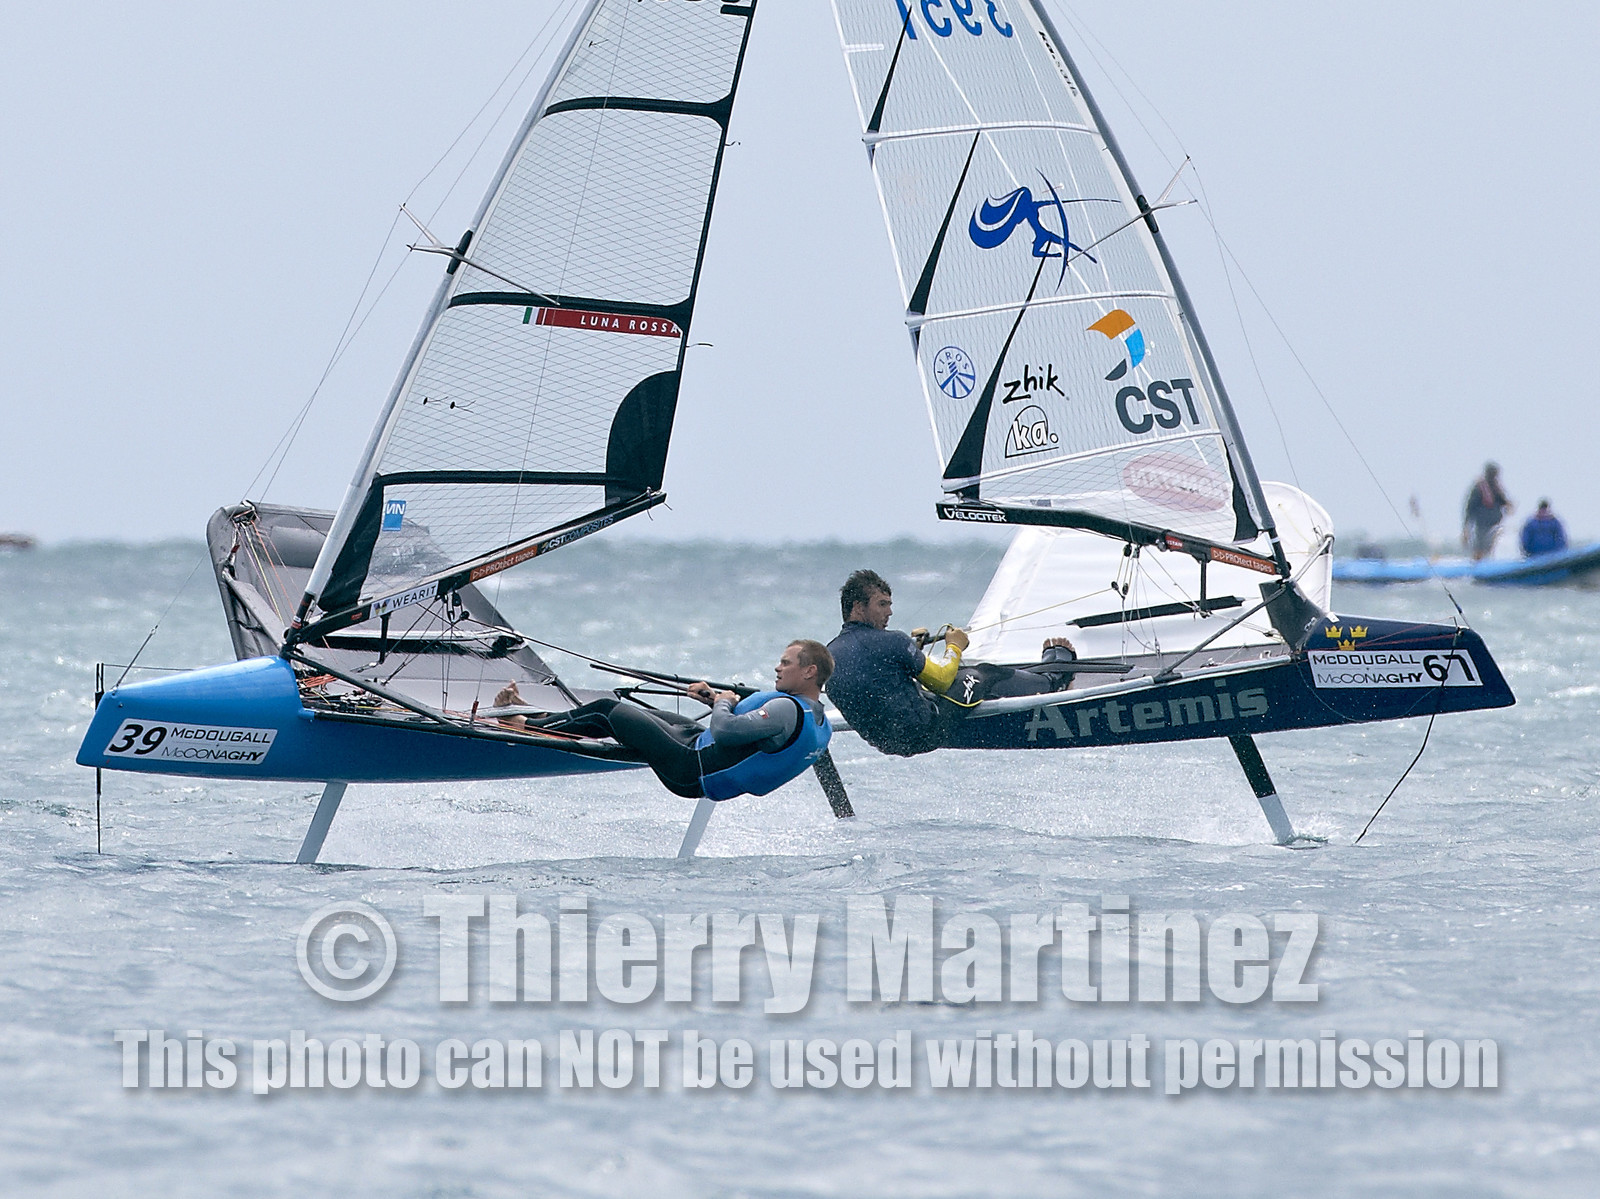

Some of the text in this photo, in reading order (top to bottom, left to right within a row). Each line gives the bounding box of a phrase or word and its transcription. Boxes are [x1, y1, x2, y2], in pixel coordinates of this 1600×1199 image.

[580, 315, 679, 334] LUNA ROSSA
[937, 351, 970, 374] LIROS
[1002, 363, 1066, 405] zhik
[1115, 378, 1200, 434] CST
[943, 507, 1007, 522] VELOCITEK
[393, 585, 437, 608] WEARIT
[1423, 655, 1475, 682] 67
[1024, 679, 1268, 741] Artemis
[109, 724, 168, 755] 39
